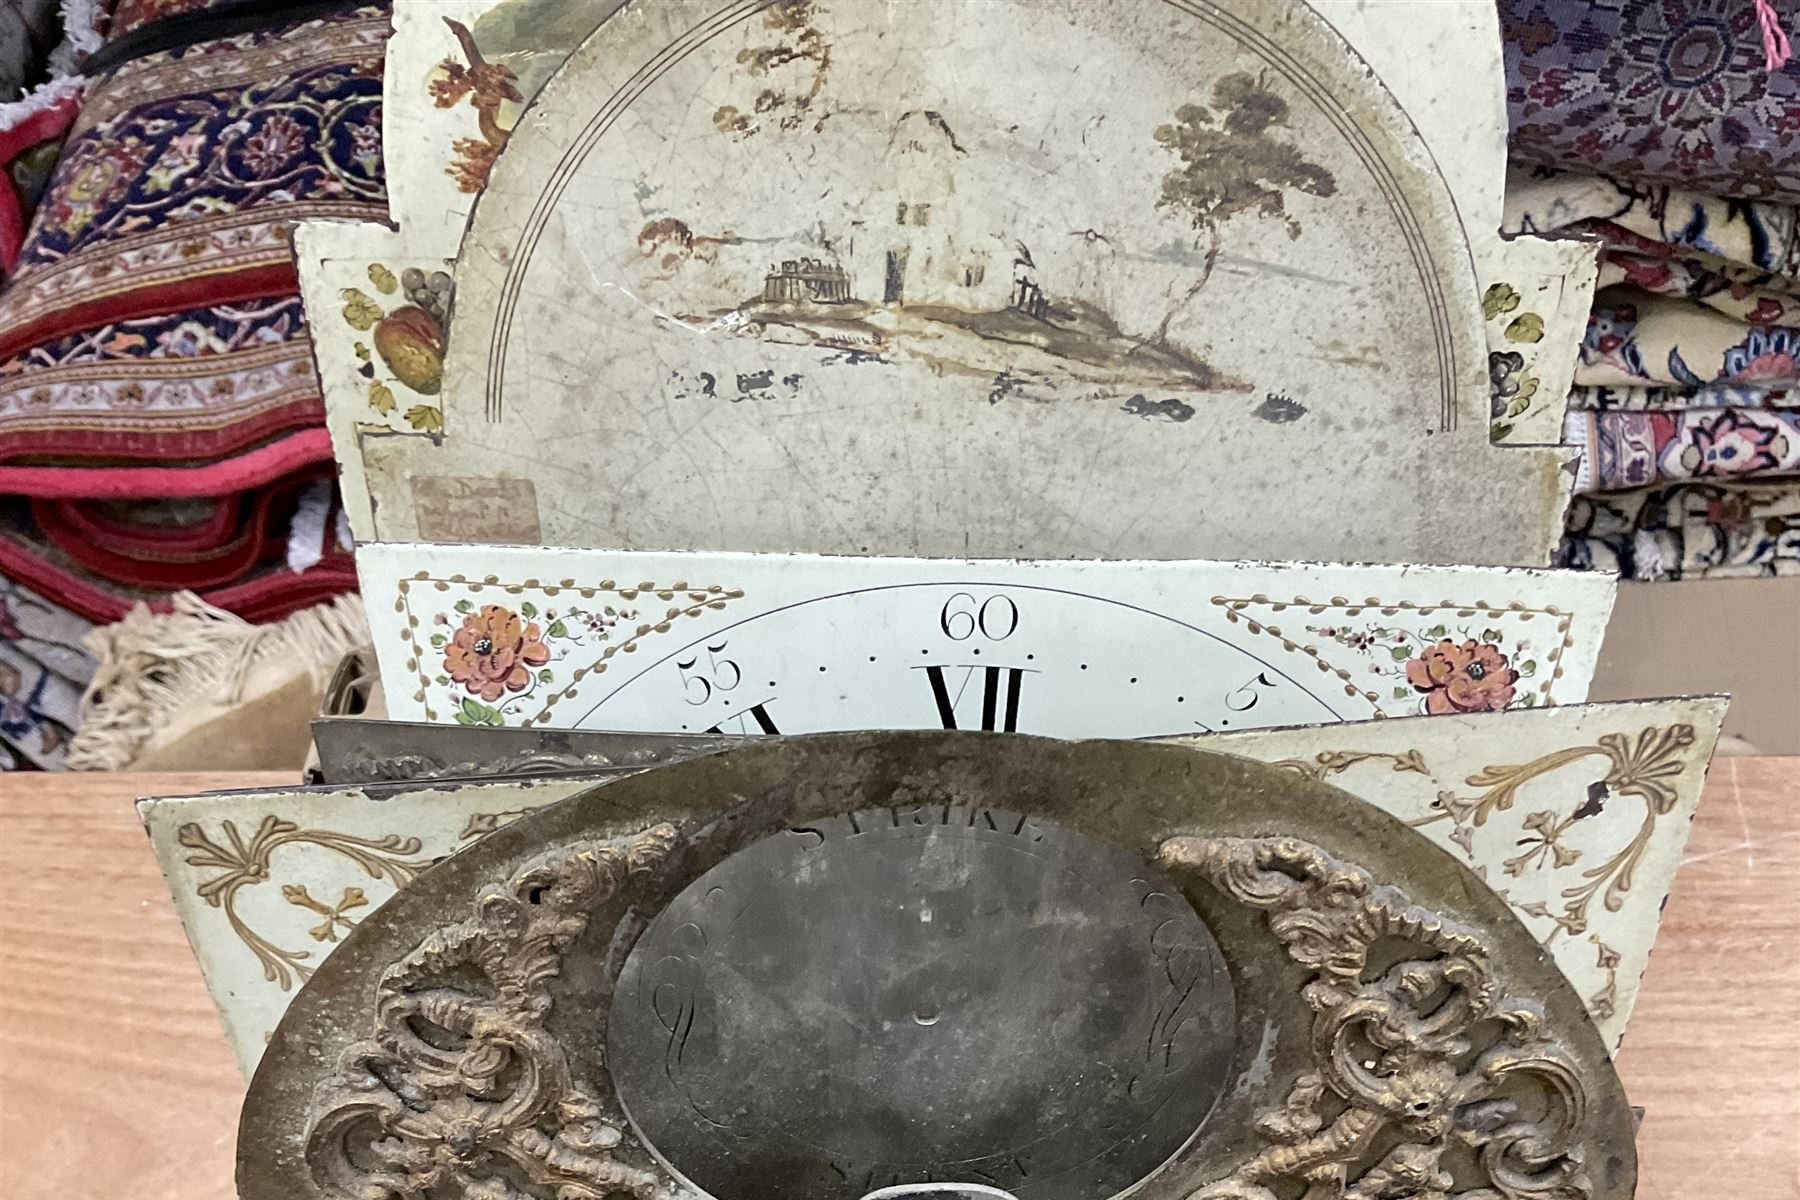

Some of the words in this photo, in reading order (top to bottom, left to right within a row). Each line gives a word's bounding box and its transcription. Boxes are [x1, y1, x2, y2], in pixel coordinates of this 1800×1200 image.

[940, 592, 1018, 641] 60
[677, 640, 740, 706] 55
[1224, 671, 1276, 712] 5
